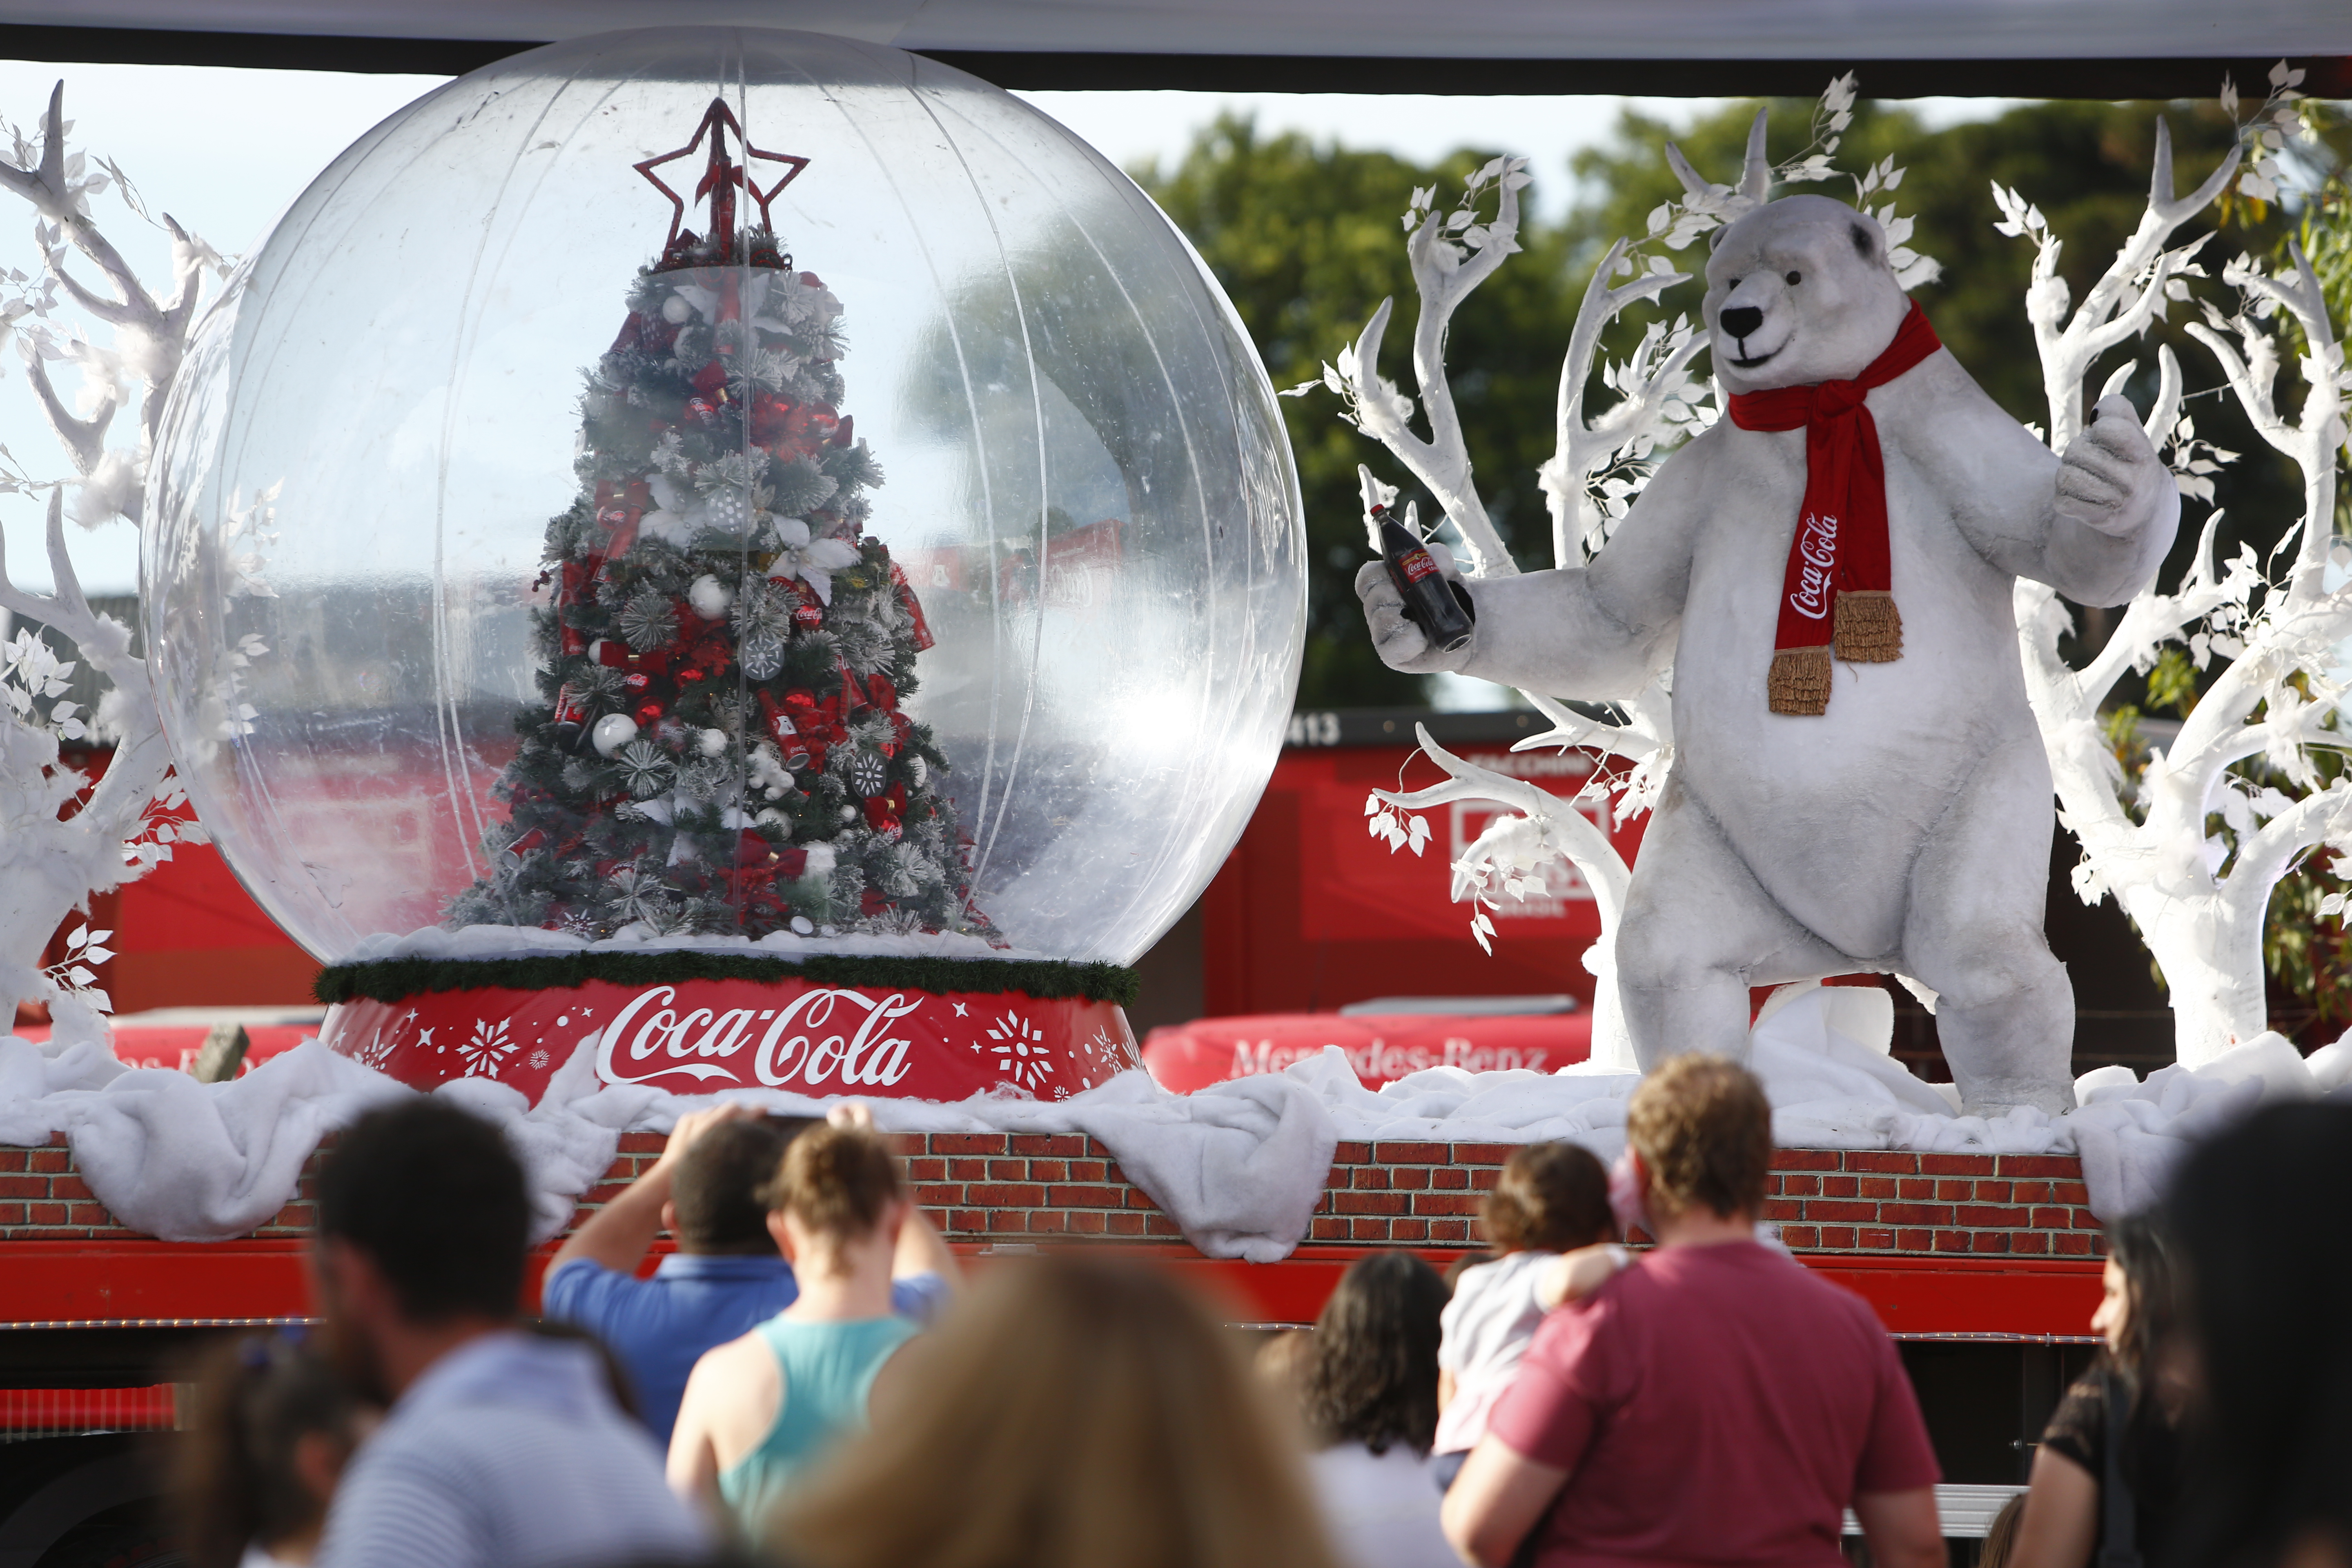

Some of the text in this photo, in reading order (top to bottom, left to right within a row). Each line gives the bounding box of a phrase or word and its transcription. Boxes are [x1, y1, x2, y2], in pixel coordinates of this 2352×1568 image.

[1790, 512, 1838, 619] Coca-Cola
[595, 985, 925, 1087] Coca-Cola
[1230, 1037, 1548, 1079] Merdes-Benz
